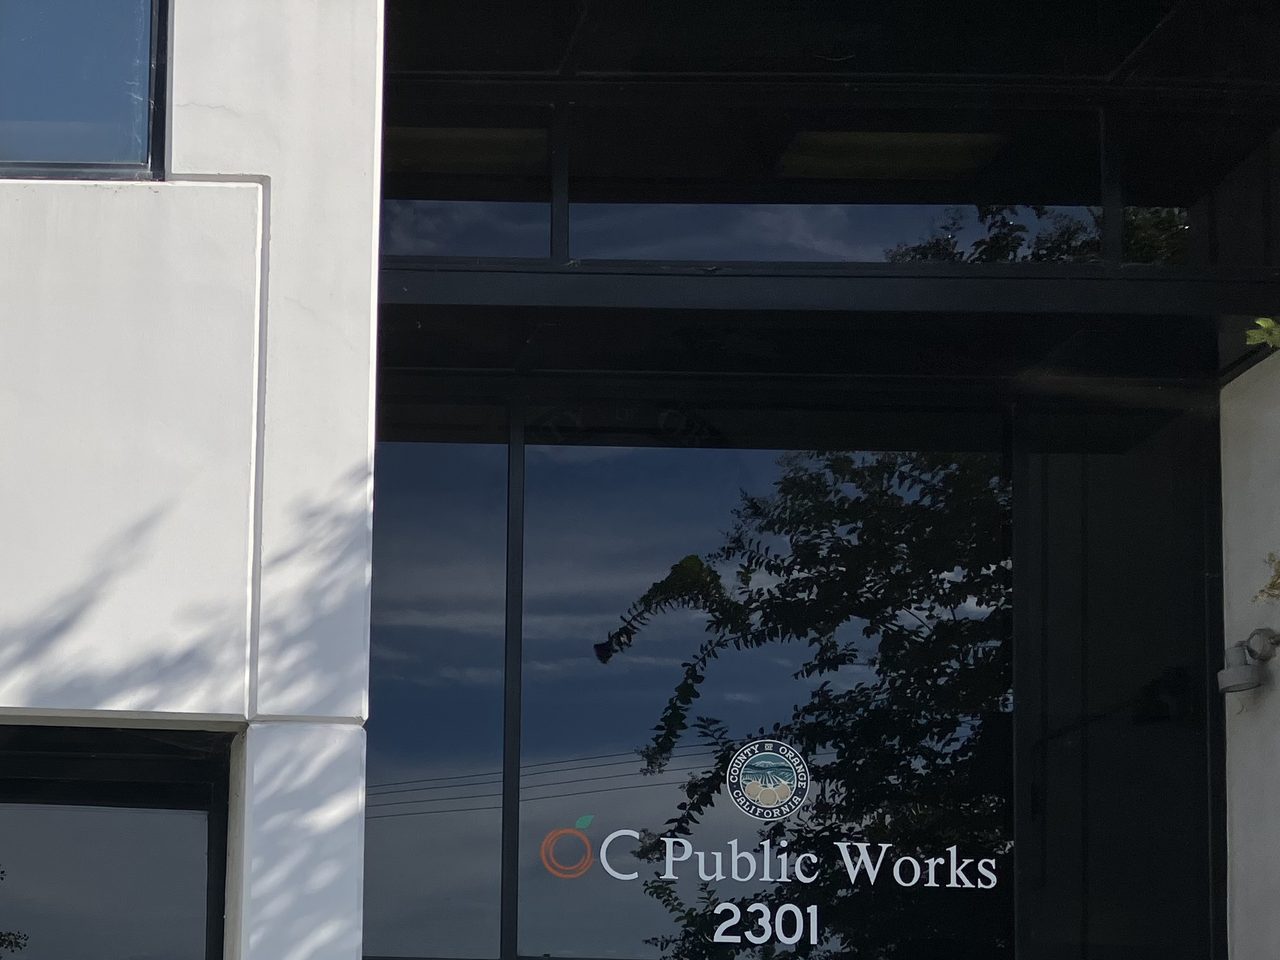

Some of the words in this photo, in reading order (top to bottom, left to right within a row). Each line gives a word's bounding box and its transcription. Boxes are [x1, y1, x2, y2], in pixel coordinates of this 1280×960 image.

[730, 744, 759, 783] COUNTY
[764, 743, 773, 751] OF
[779, 746, 807, 788] ORANGE
[733, 790, 801, 818] CALIFORNIA
[659, 836, 819, 883] Public
[834, 841, 998, 890] Works
[713, 903, 818, 944] 2301
